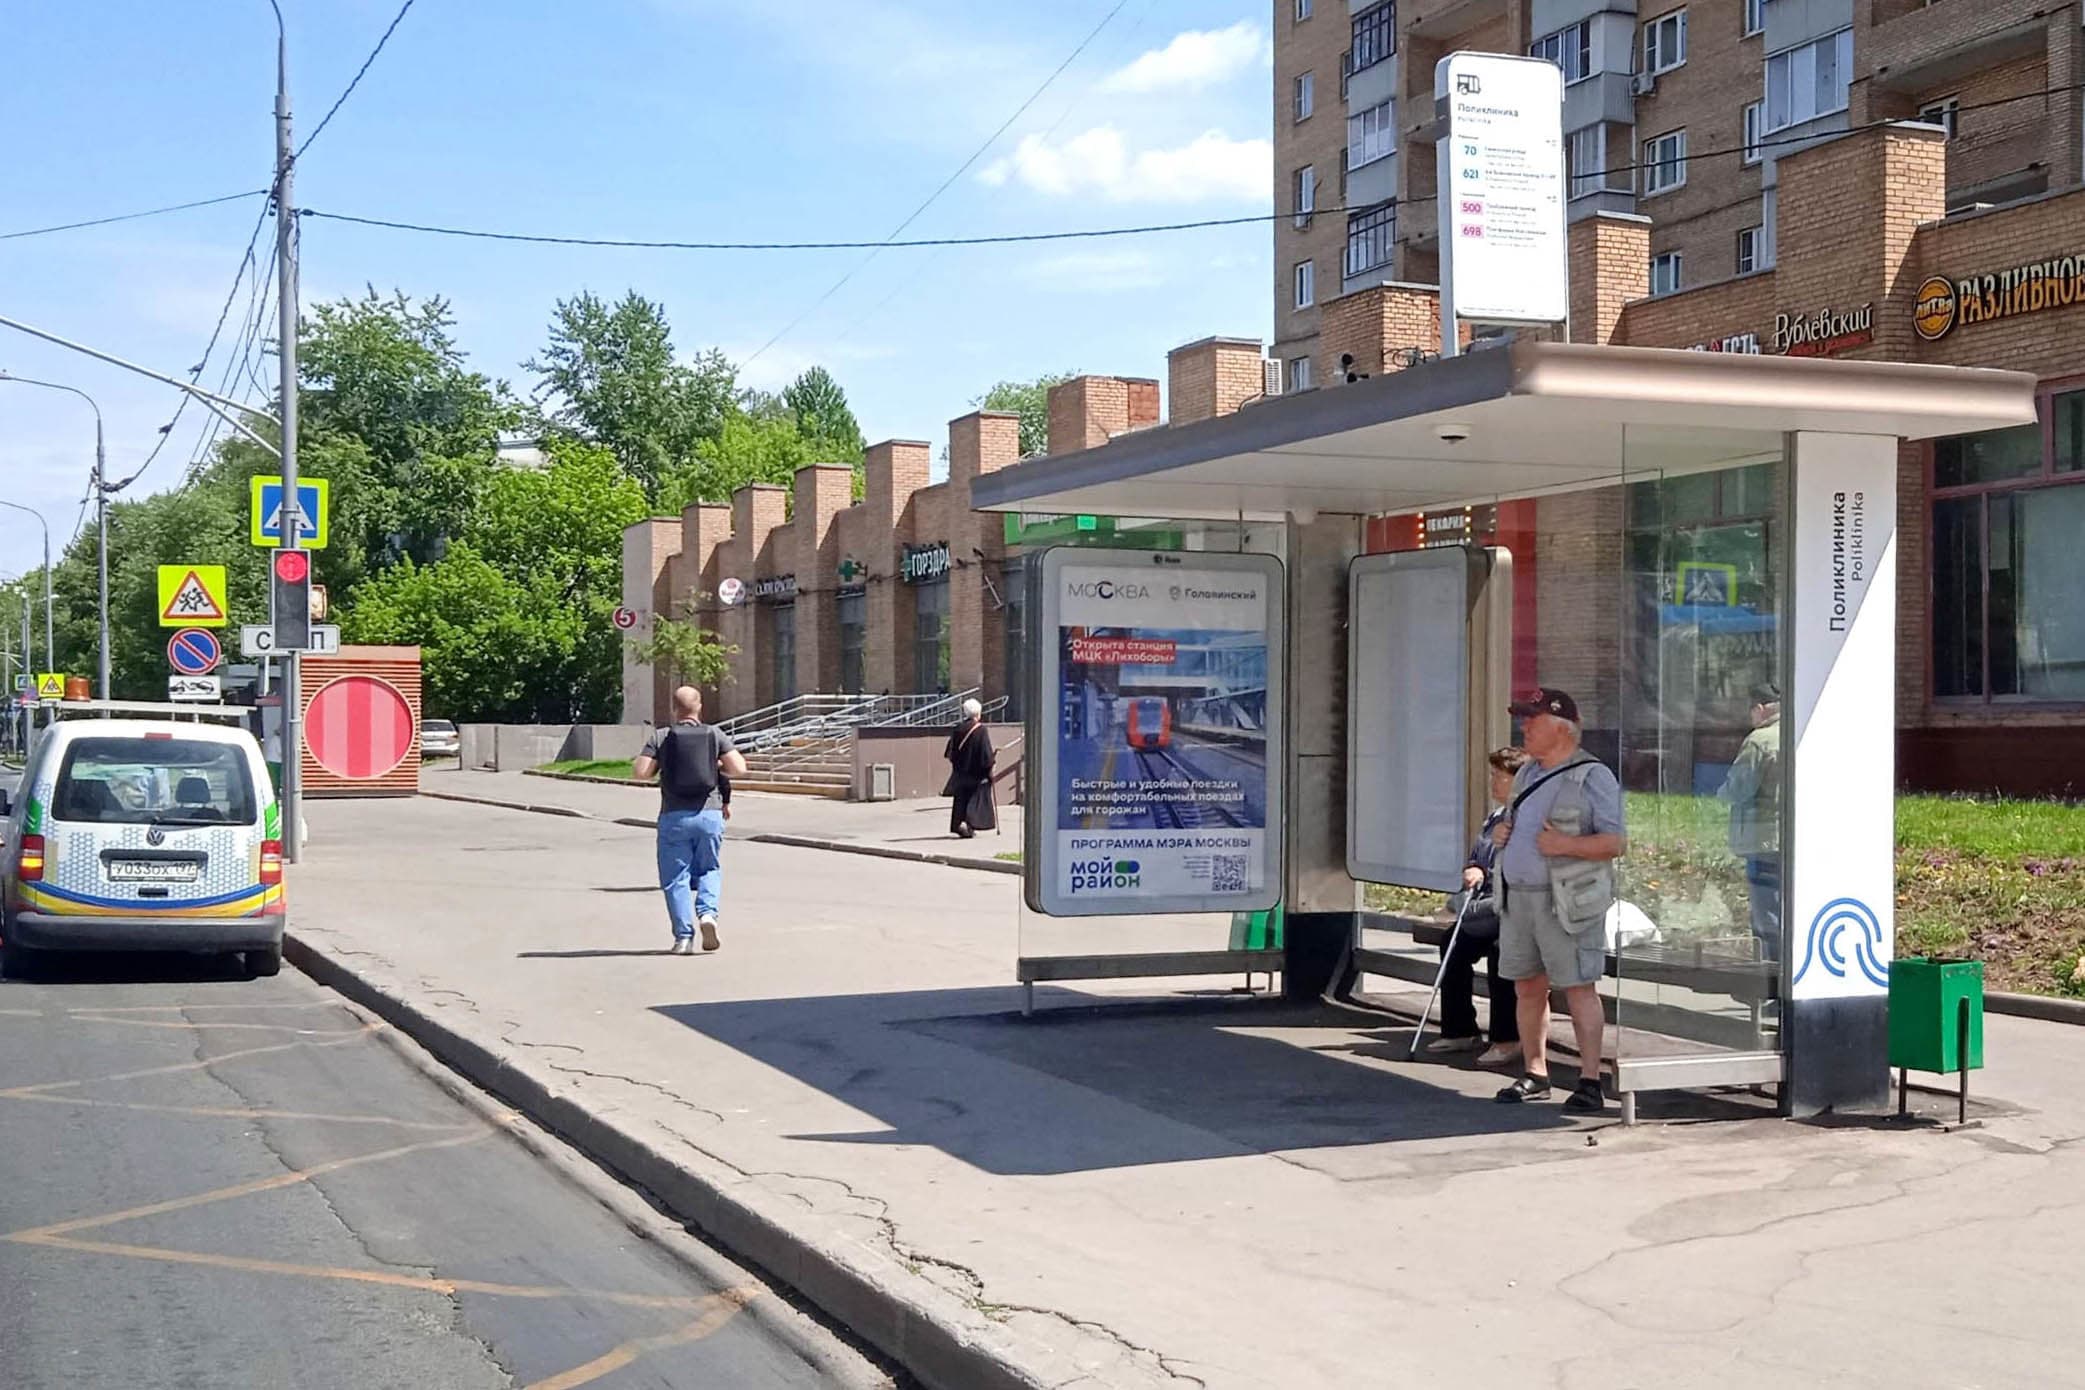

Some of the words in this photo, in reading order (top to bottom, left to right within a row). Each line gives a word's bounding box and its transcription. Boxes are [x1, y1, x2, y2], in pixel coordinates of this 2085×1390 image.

[1464, 145, 1477, 156] 70
[1463, 169, 1479, 179] 621
[1462, 203, 1481, 213] 500
[1463, 226, 1482, 237] 698
[1772, 301, 1873, 355] Рублёвский
[1851, 491, 1863, 581] Poliklinika
[1829, 491, 1846, 632] Поликлиника
[1068, 580, 1150, 599] МОСКВА
[1073, 639, 1125, 651] Открыта
[1127, 641, 1173, 651] станция
[1073, 650, 1102, 661] МЦК
[1071, 779, 1127, 790] Быстрые
[1129, 780, 1137, 789] и
[1139, 779, 1191, 792] удобные
[1192, 780, 1238, 791] поездки
[1071, 794, 1086, 802] на
[1088, 791, 1198, 805] комфортабельных
[1071, 807, 1093, 816] для
[1095, 806, 1146, 817] горожан
[1071, 839, 1153, 849] ПРОГРАММА
[1156, 838, 1193, 849] МЭРА
[1194, 838, 1250, 848] МОСКВЫ
[1070, 856, 1113, 874] мой
